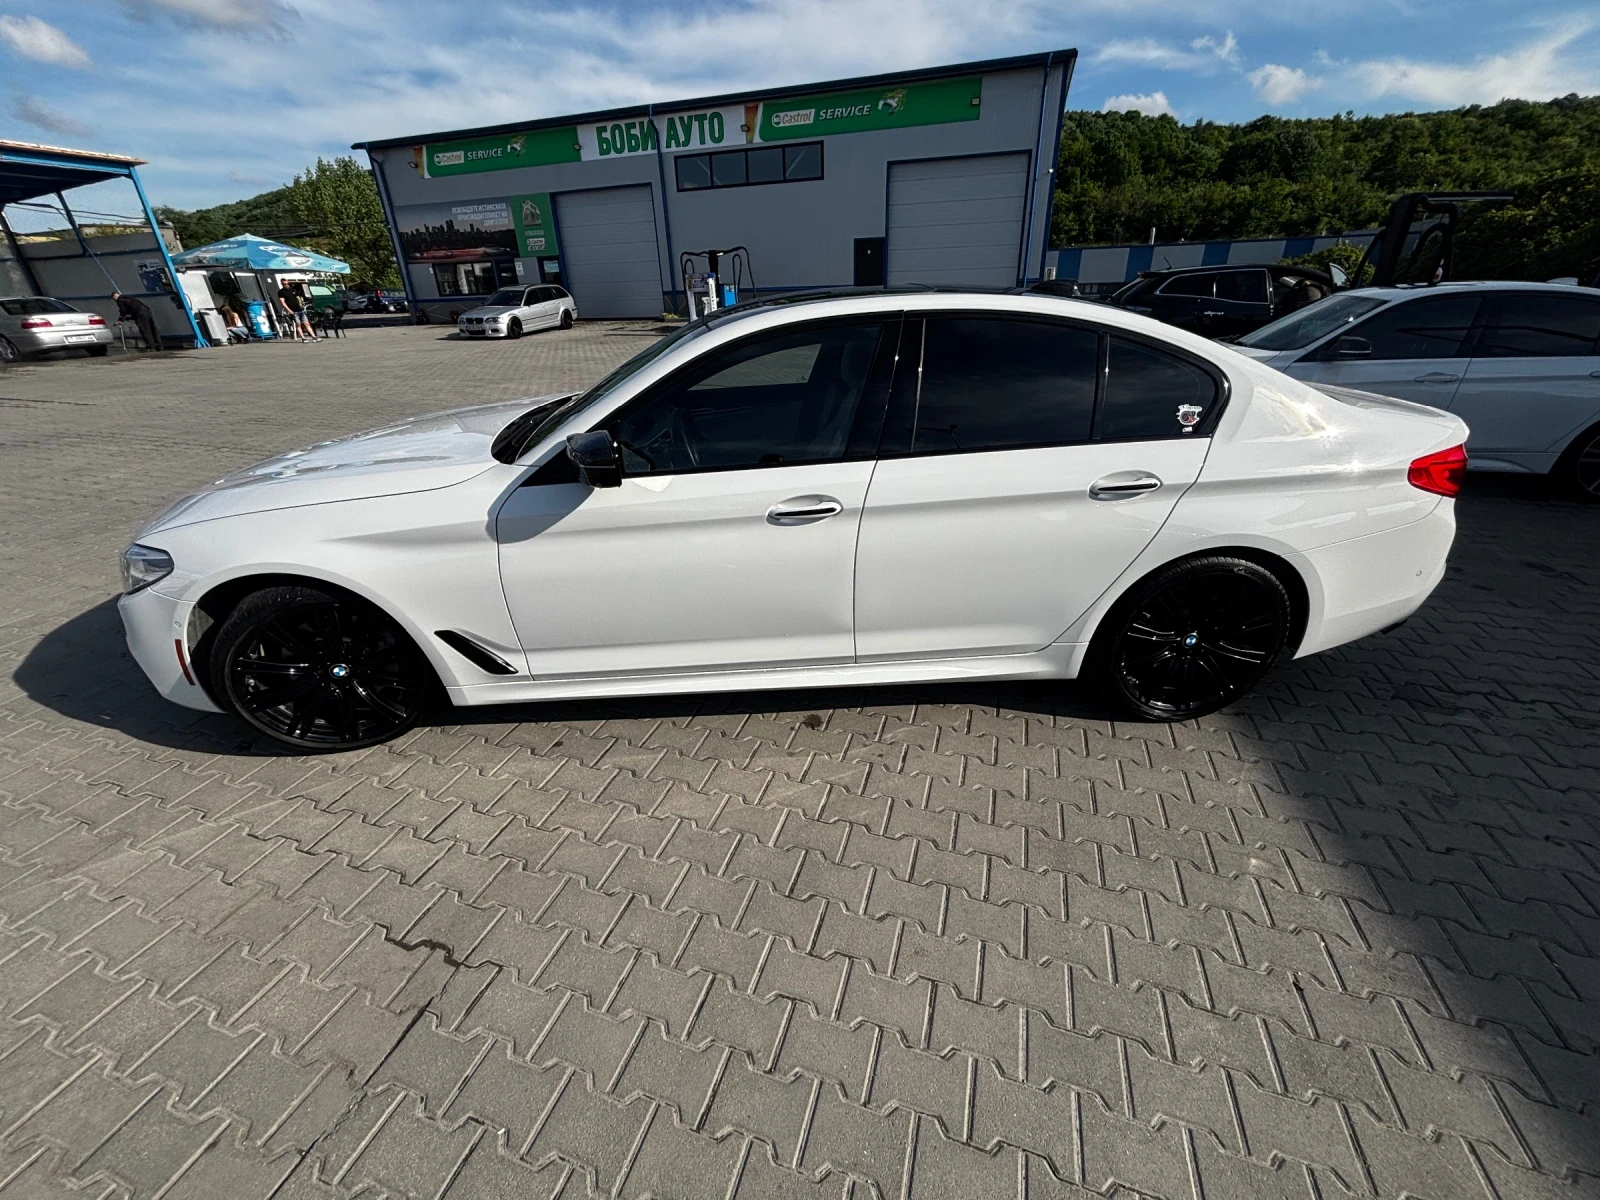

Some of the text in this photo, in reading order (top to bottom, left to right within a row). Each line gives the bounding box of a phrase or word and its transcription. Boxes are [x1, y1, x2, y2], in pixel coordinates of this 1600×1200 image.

[782, 104, 871, 124] Castrol SERVICE
[596, 111, 725, 156] БОБИ АУТО
[441, 148, 503, 164] Castrol SERVICE
[527, 244, 546, 252] EDGE
